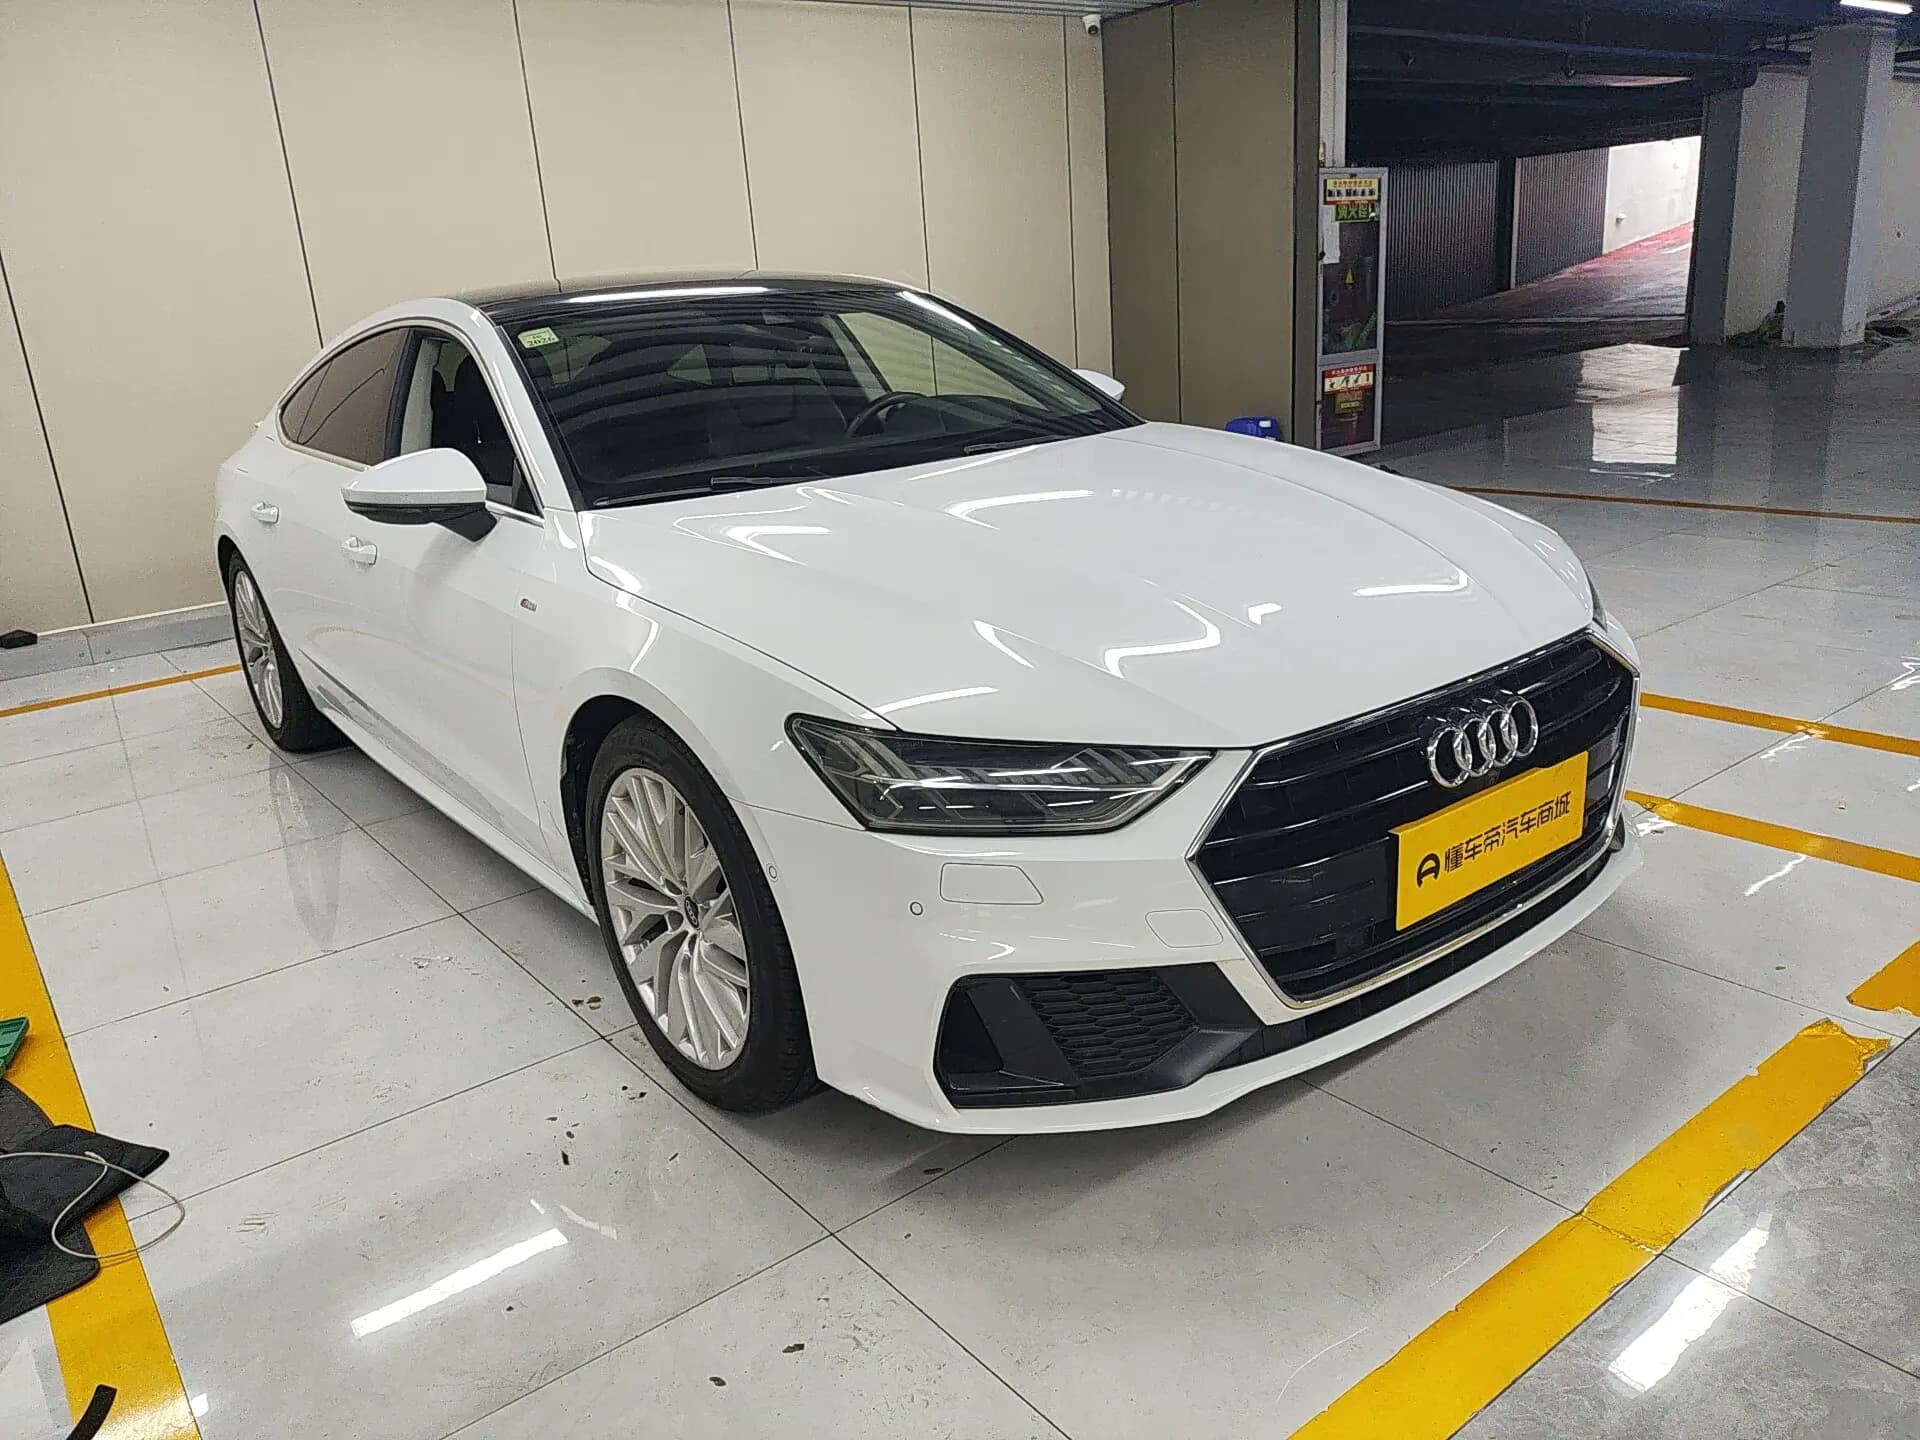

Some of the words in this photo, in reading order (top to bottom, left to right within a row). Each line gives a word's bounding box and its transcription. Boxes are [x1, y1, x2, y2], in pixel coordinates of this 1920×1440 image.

[1444, 791, 1571, 872] 懂车帝汽车商城
